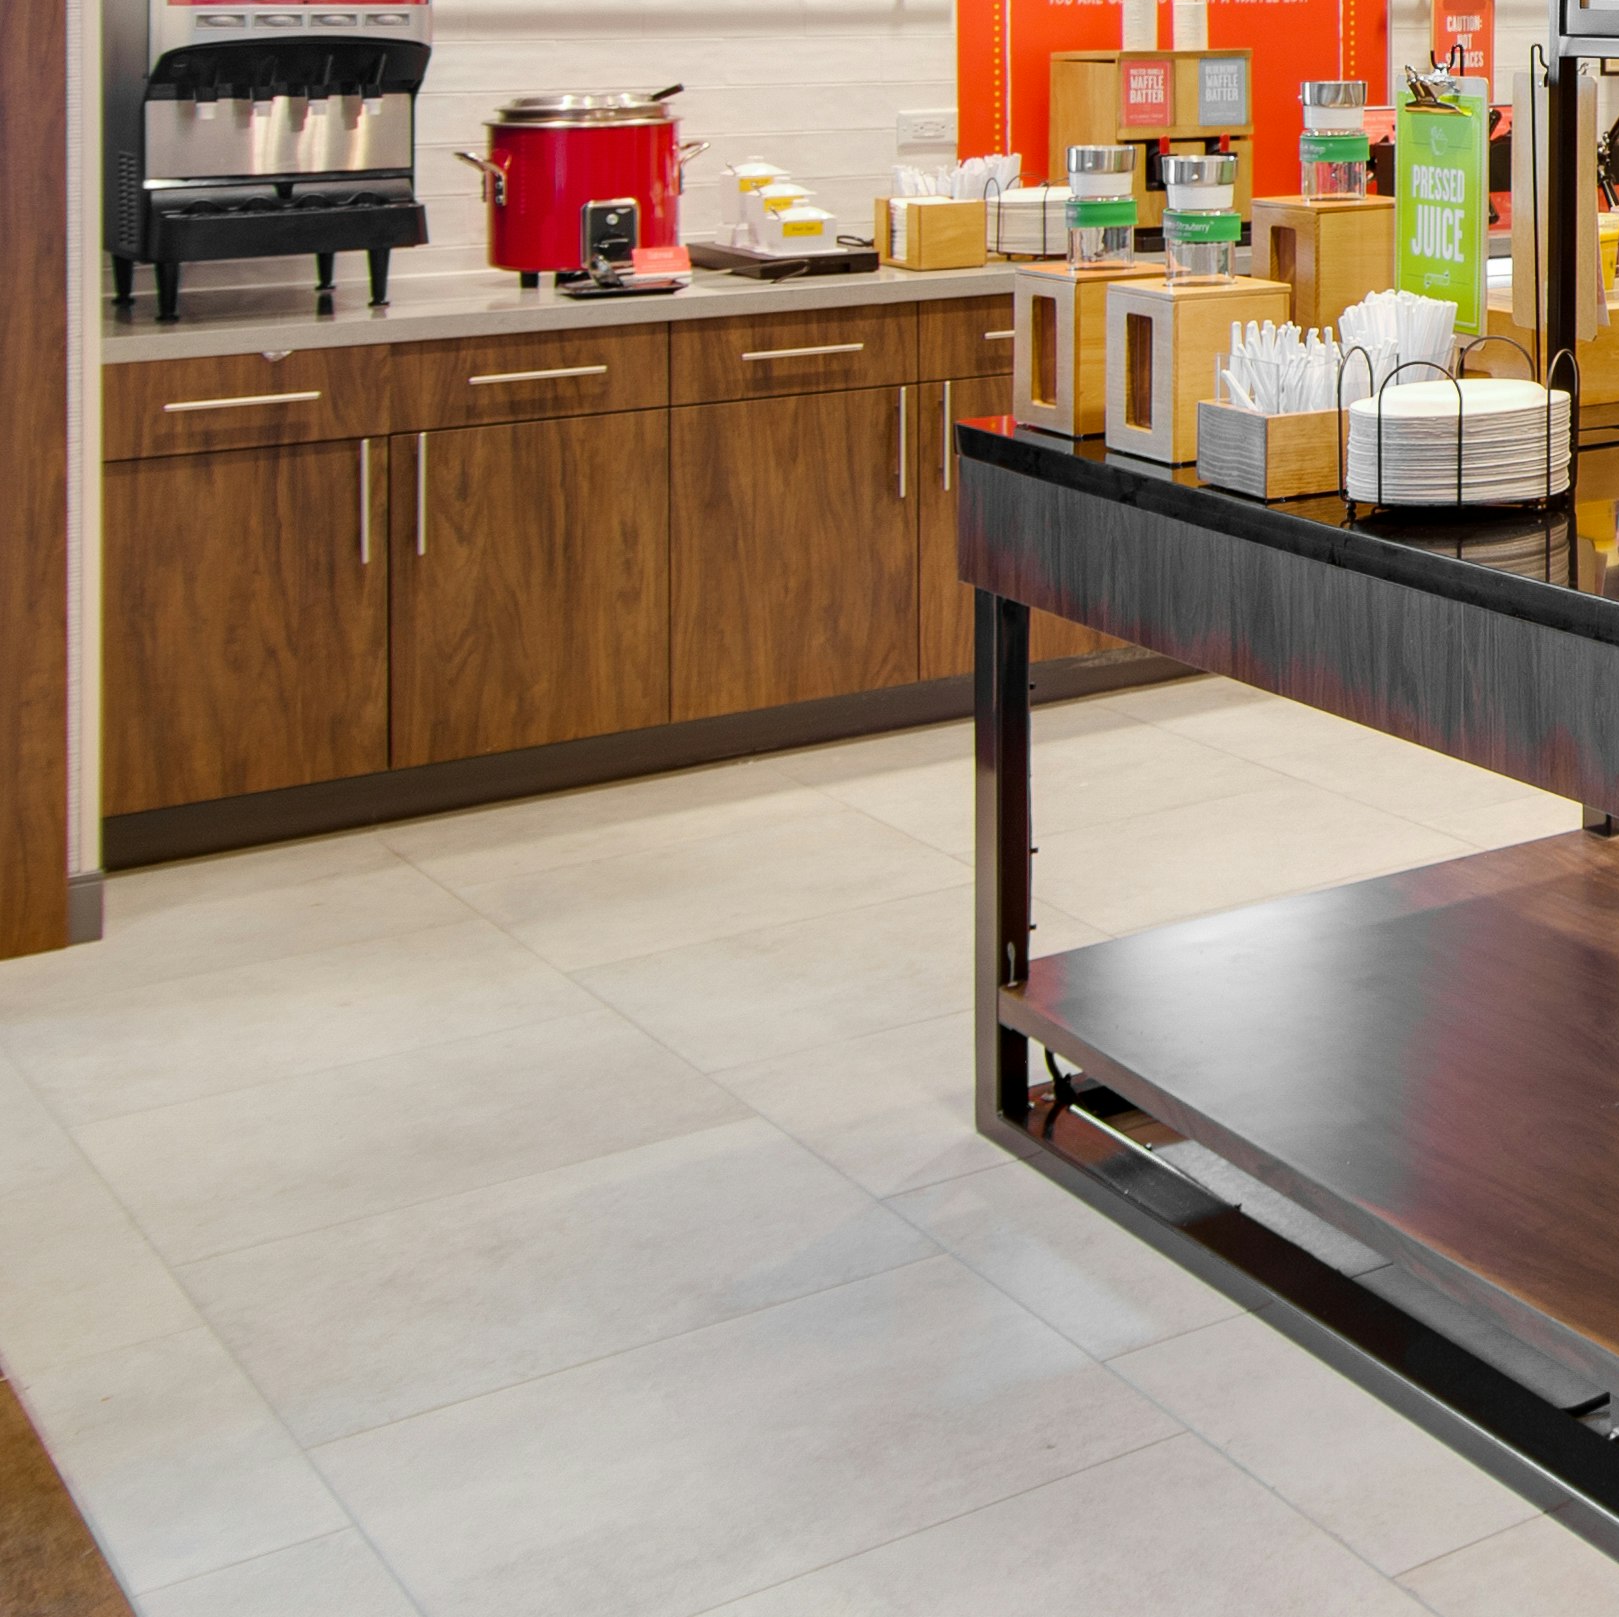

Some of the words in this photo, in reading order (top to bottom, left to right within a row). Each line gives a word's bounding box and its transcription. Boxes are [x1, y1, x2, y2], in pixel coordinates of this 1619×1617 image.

[1446, 15, 1482, 32] CAUTION:
[1456, 33, 1472, 50] HOT
[1130, 76, 1164, 89] WAFFLE
[1205, 74, 1238, 88] WAFFLE
[1129, 89, 1164, 104] BATTER
[1205, 88, 1239, 103] BATTER
[1411, 164, 1466, 204] PRESSED
[1411, 204, 1466, 263] JUICE
